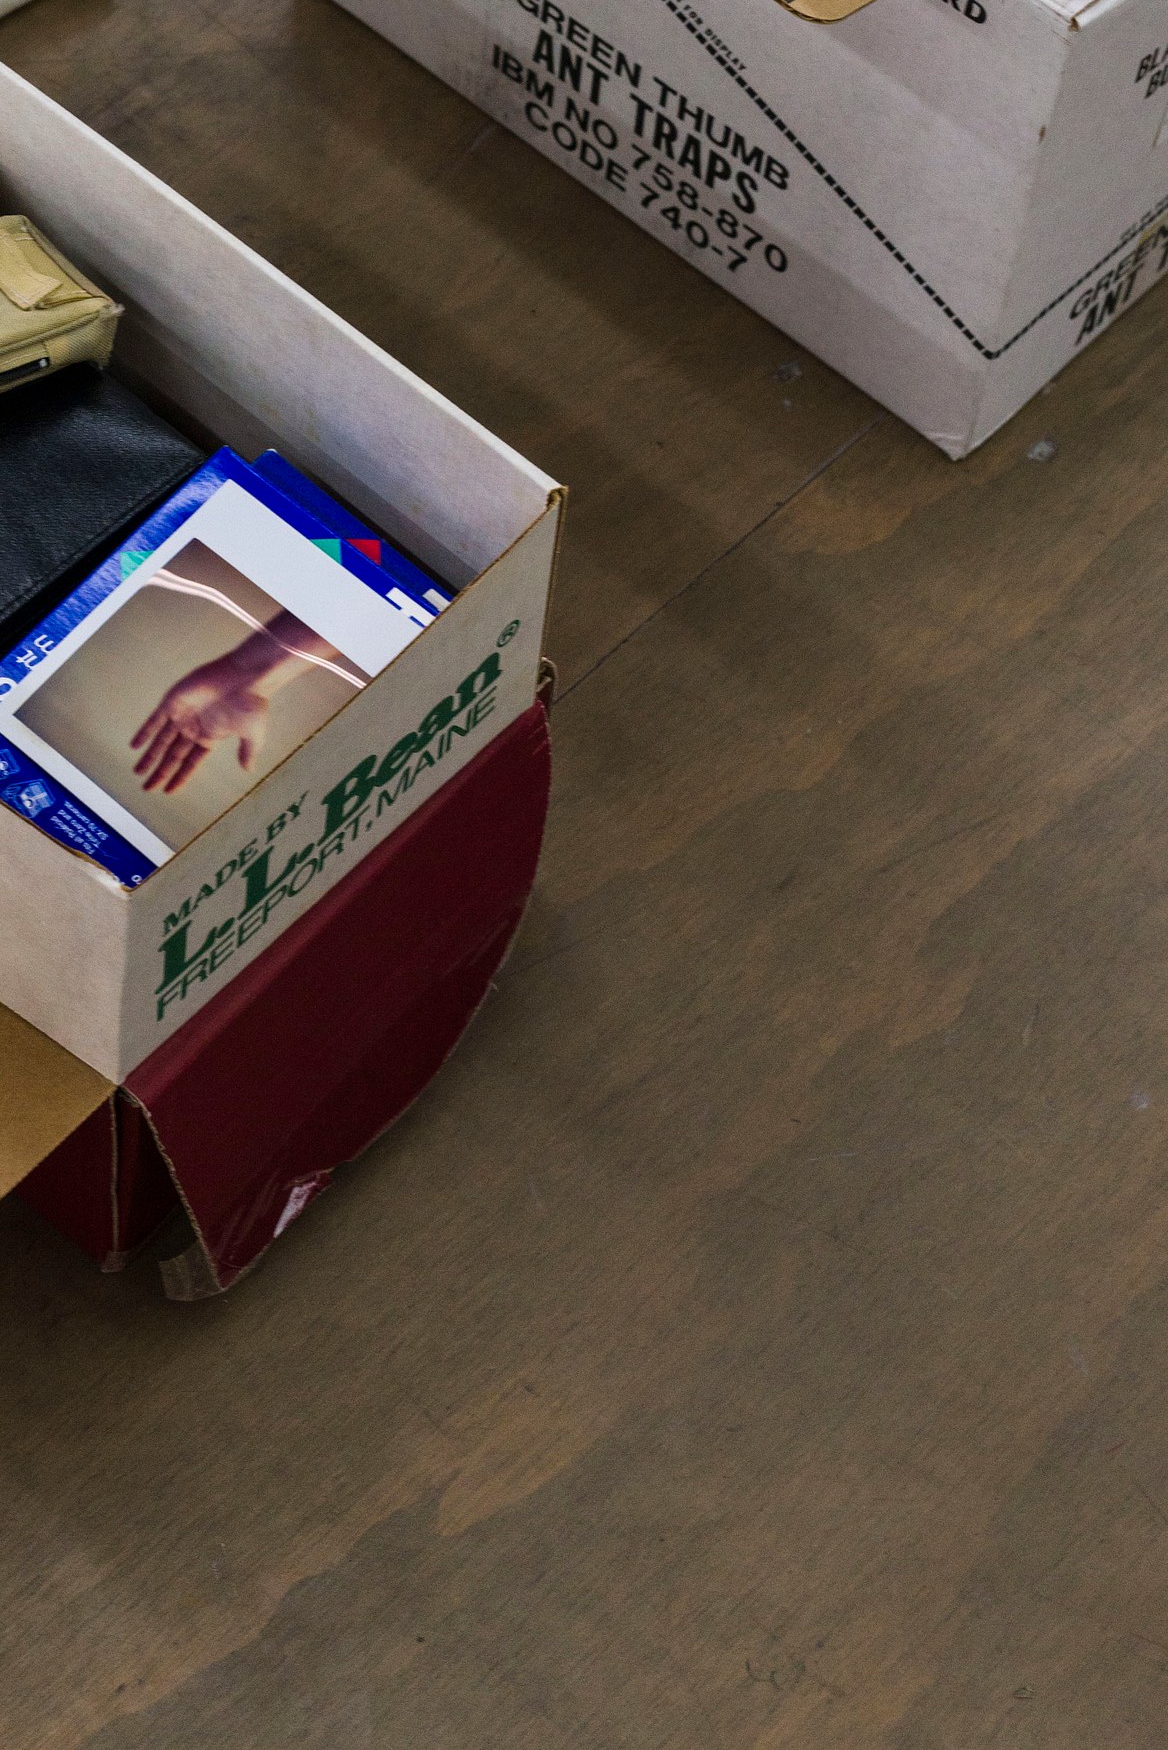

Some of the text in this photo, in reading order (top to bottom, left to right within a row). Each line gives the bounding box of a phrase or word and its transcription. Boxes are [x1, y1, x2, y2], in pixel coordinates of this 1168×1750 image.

[533, 29, 759, 214] ANT TRAPS
[683, 4, 703, 25] FOR
[704, 28, 747, 71] DISPLAY
[491, 44, 788, 273] IBM NO 758-870
[524, 101, 748, 273] CODE 740-7
[653, 76, 790, 190] THUMB
[156, 686, 499, 1022] FREEPORT, MAINE
[163, 789, 311, 936] MADE BY
